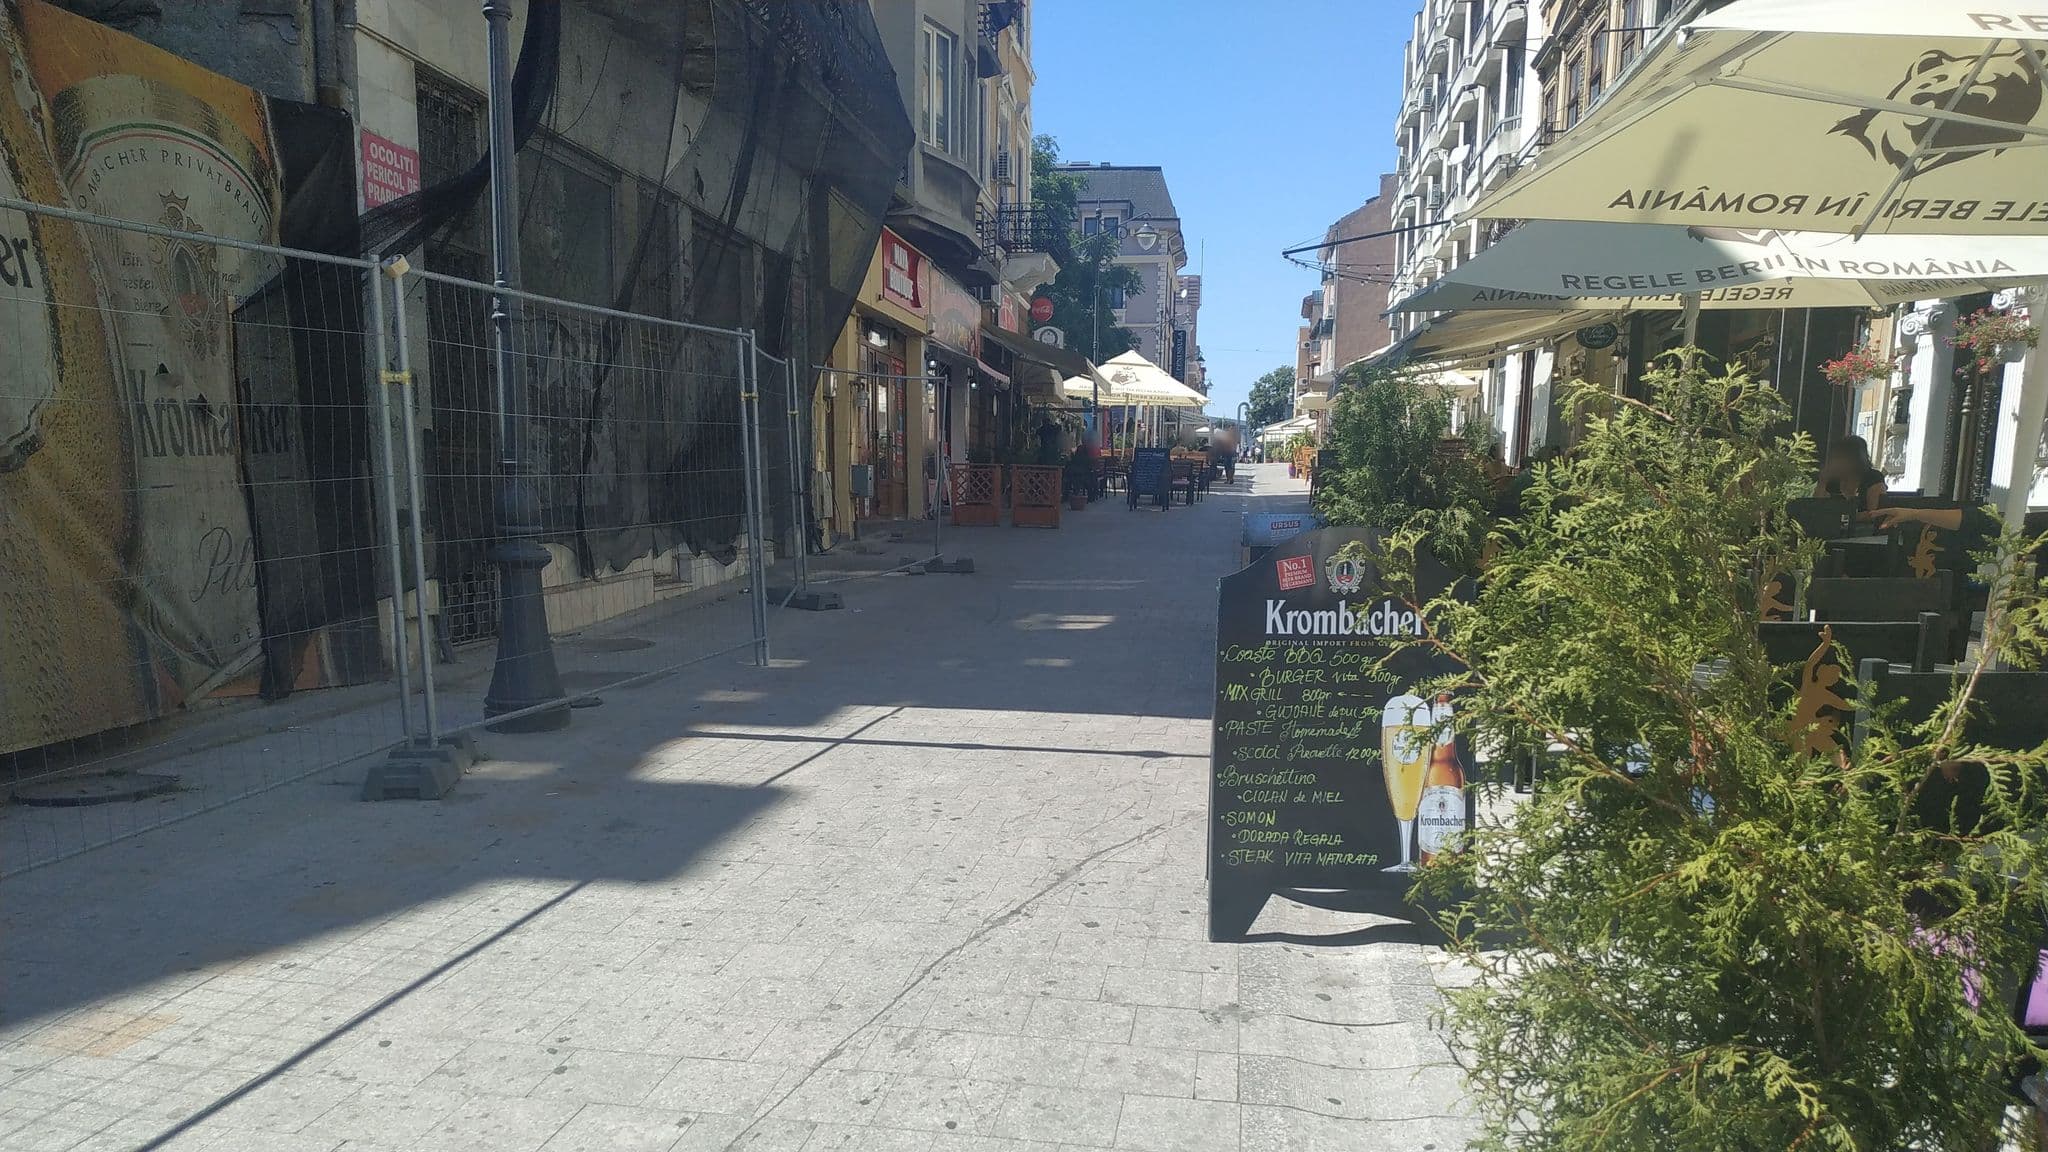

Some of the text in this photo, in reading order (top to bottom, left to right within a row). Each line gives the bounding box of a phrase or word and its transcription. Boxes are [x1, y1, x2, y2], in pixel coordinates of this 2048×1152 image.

[369, 142, 414, 174] OCOLITI
[366, 160, 405, 191] PERICOL
[1561, 272, 1688, 291] REGELE
[1695, 254, 1786, 282] BERII
[1839, 257, 2017, 276] ROMÂNIA
[1272, 521, 1300, 530] URSUS
[1283, 558, 1307, 571] No.1
[1259, 666, 1327, 688] BURGER
[1223, 683, 1249, 702] MIX
[1250, 687, 1284, 708] GRILL
[1226, 720, 1276, 740] PASTE
[1312, 791, 1345, 804] MIEL
[1226, 810, 1276, 827] SOMON
[1238, 829, 1345, 846] DORADA REGALA
[1228, 850, 1379, 866] STEAK VITA MATURATA
